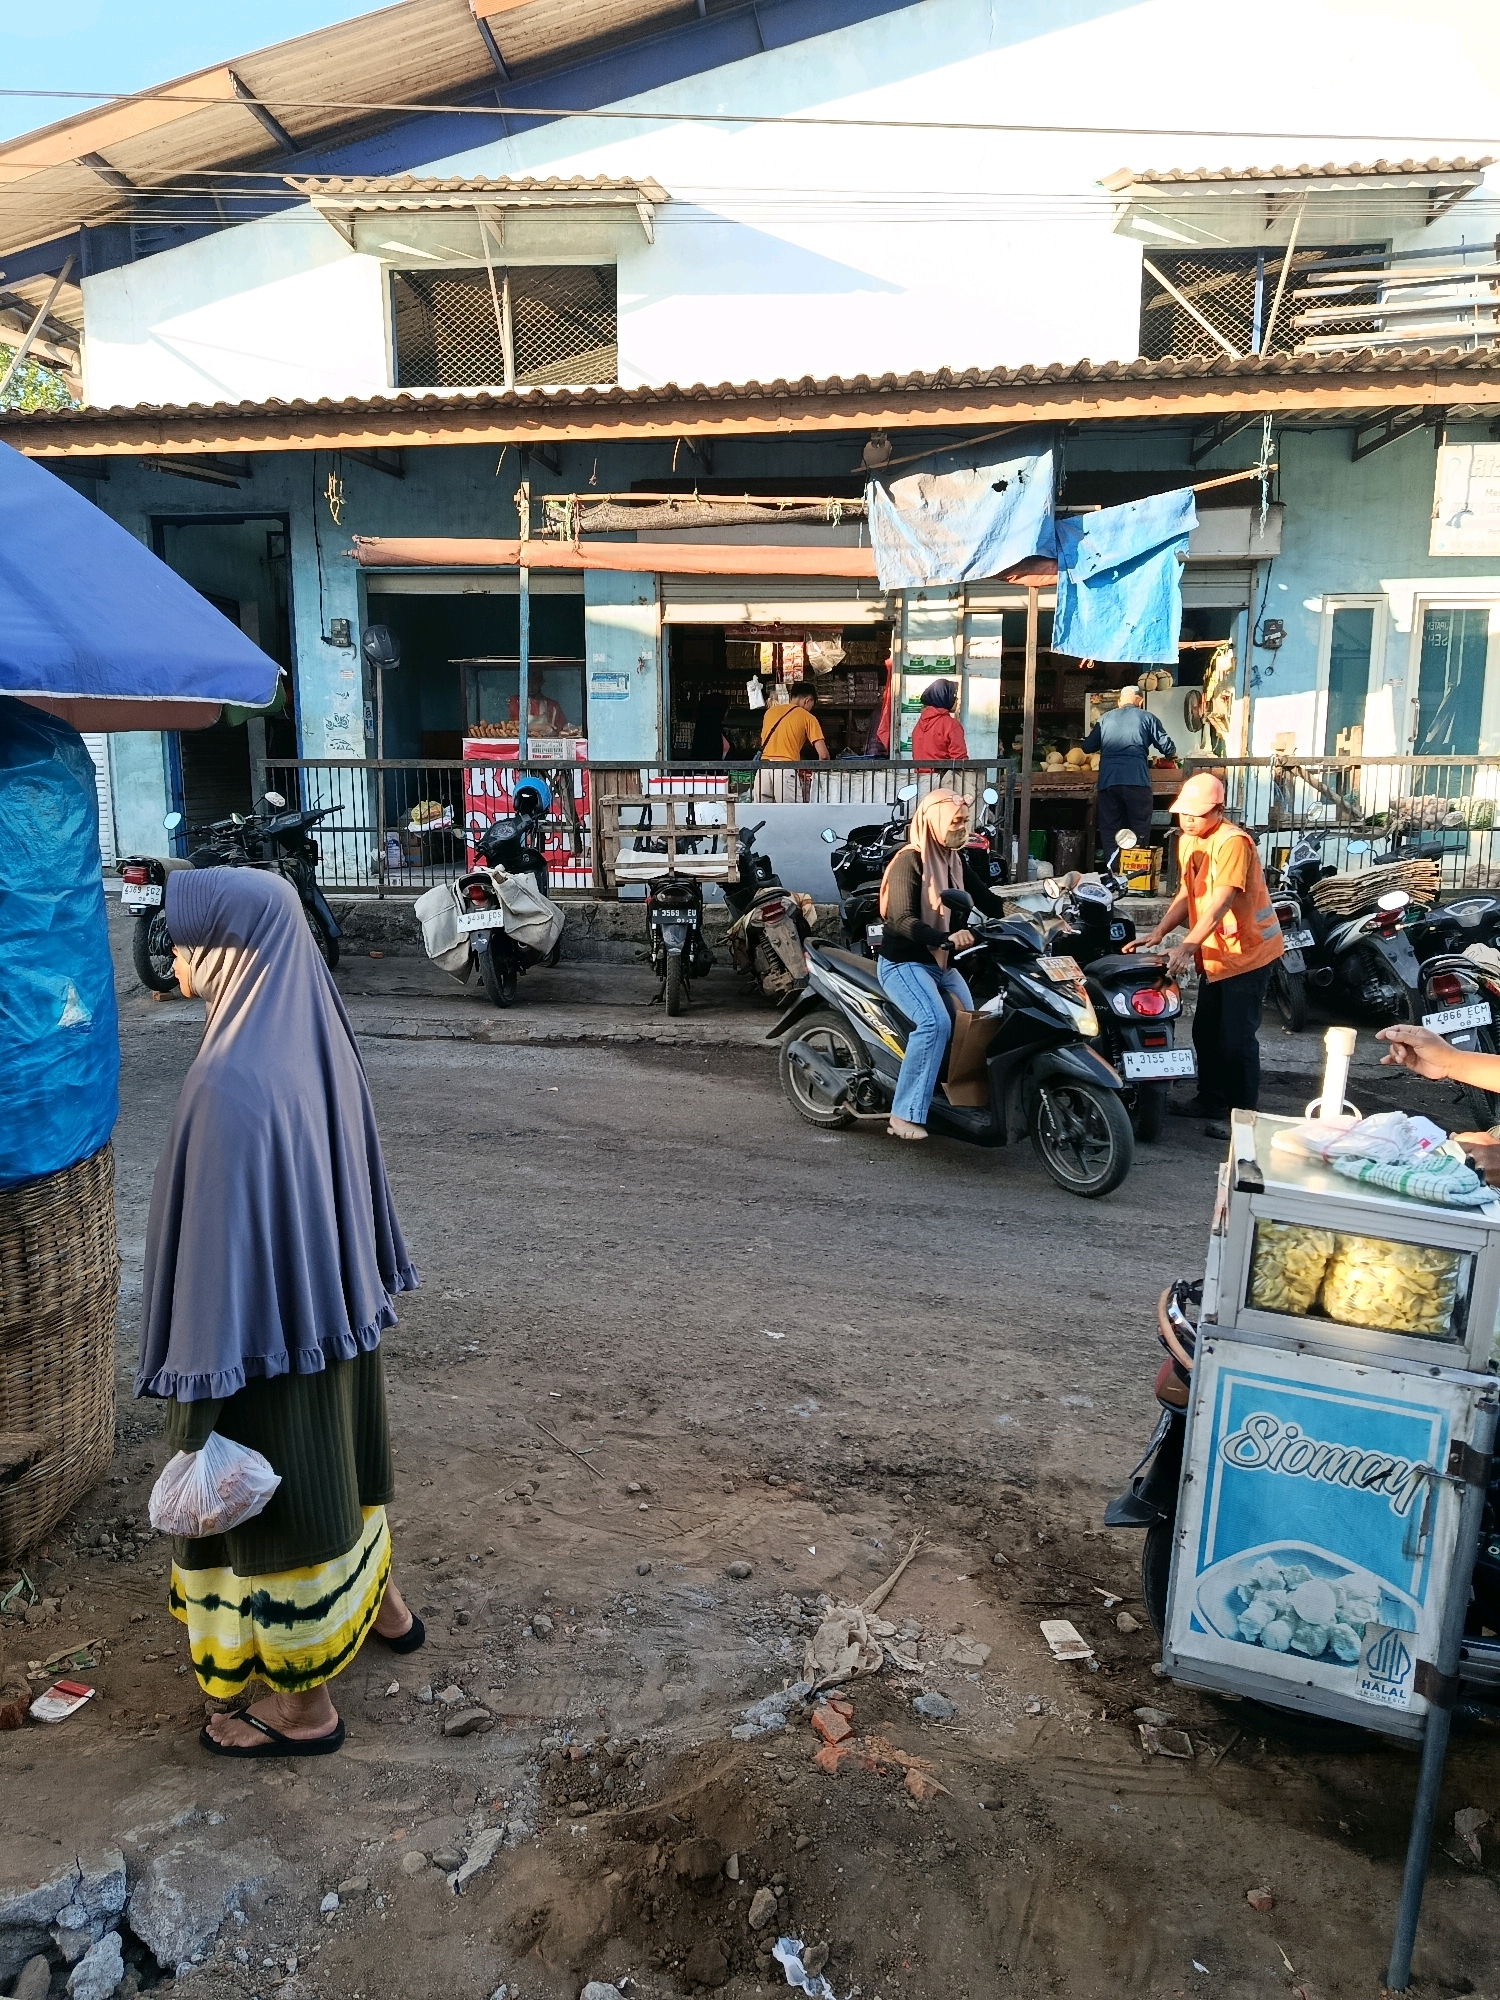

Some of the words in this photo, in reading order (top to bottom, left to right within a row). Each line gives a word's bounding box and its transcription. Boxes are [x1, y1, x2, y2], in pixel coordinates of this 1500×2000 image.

[687, 909, 697, 917] EU
[1221, 1413, 1429, 1516] Siomay
[1360, 1689, 1406, 1705] INDONESIA
[1361, 1679, 1407, 1699] HALAL
